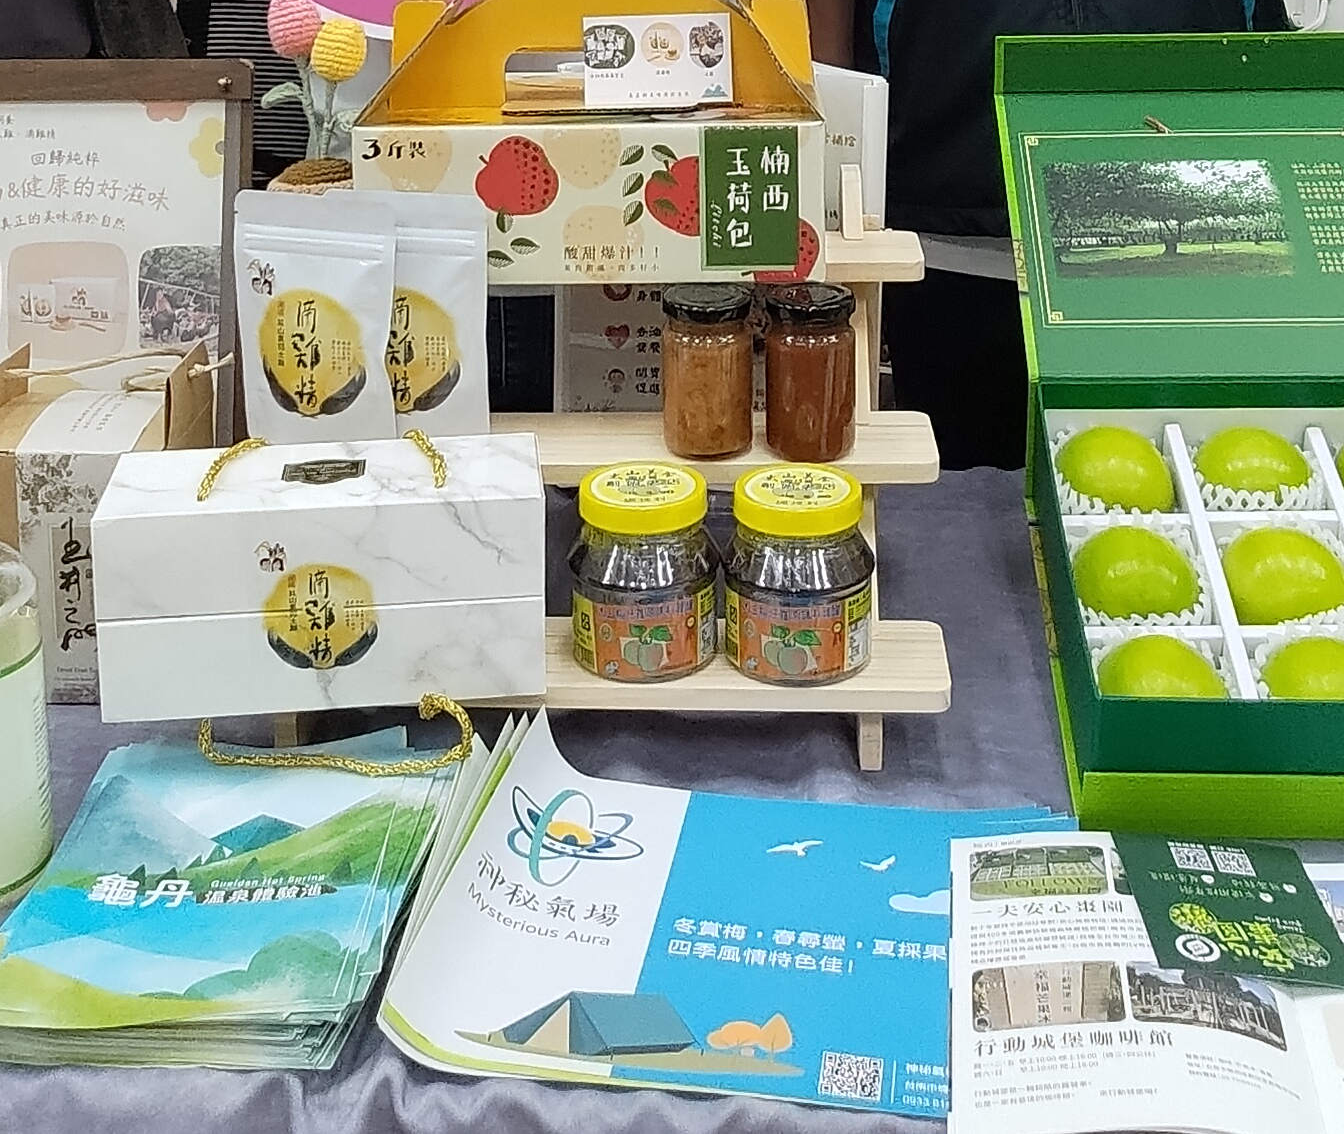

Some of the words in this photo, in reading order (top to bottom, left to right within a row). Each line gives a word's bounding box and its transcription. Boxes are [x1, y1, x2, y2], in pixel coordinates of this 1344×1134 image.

[362, 138, 427, 161] 3斤裝
[760, 145, 790, 212] 楠西
[0, 211, 127, 233] 真正的美味源於自然
[724, 147, 754, 249] 玉荷包
[88, 872, 195, 908] 龜丹
[466, 880, 560, 941] Mysterious
[565, 929, 611, 948] Aura
[477, 851, 621, 928] 神秘氣場
